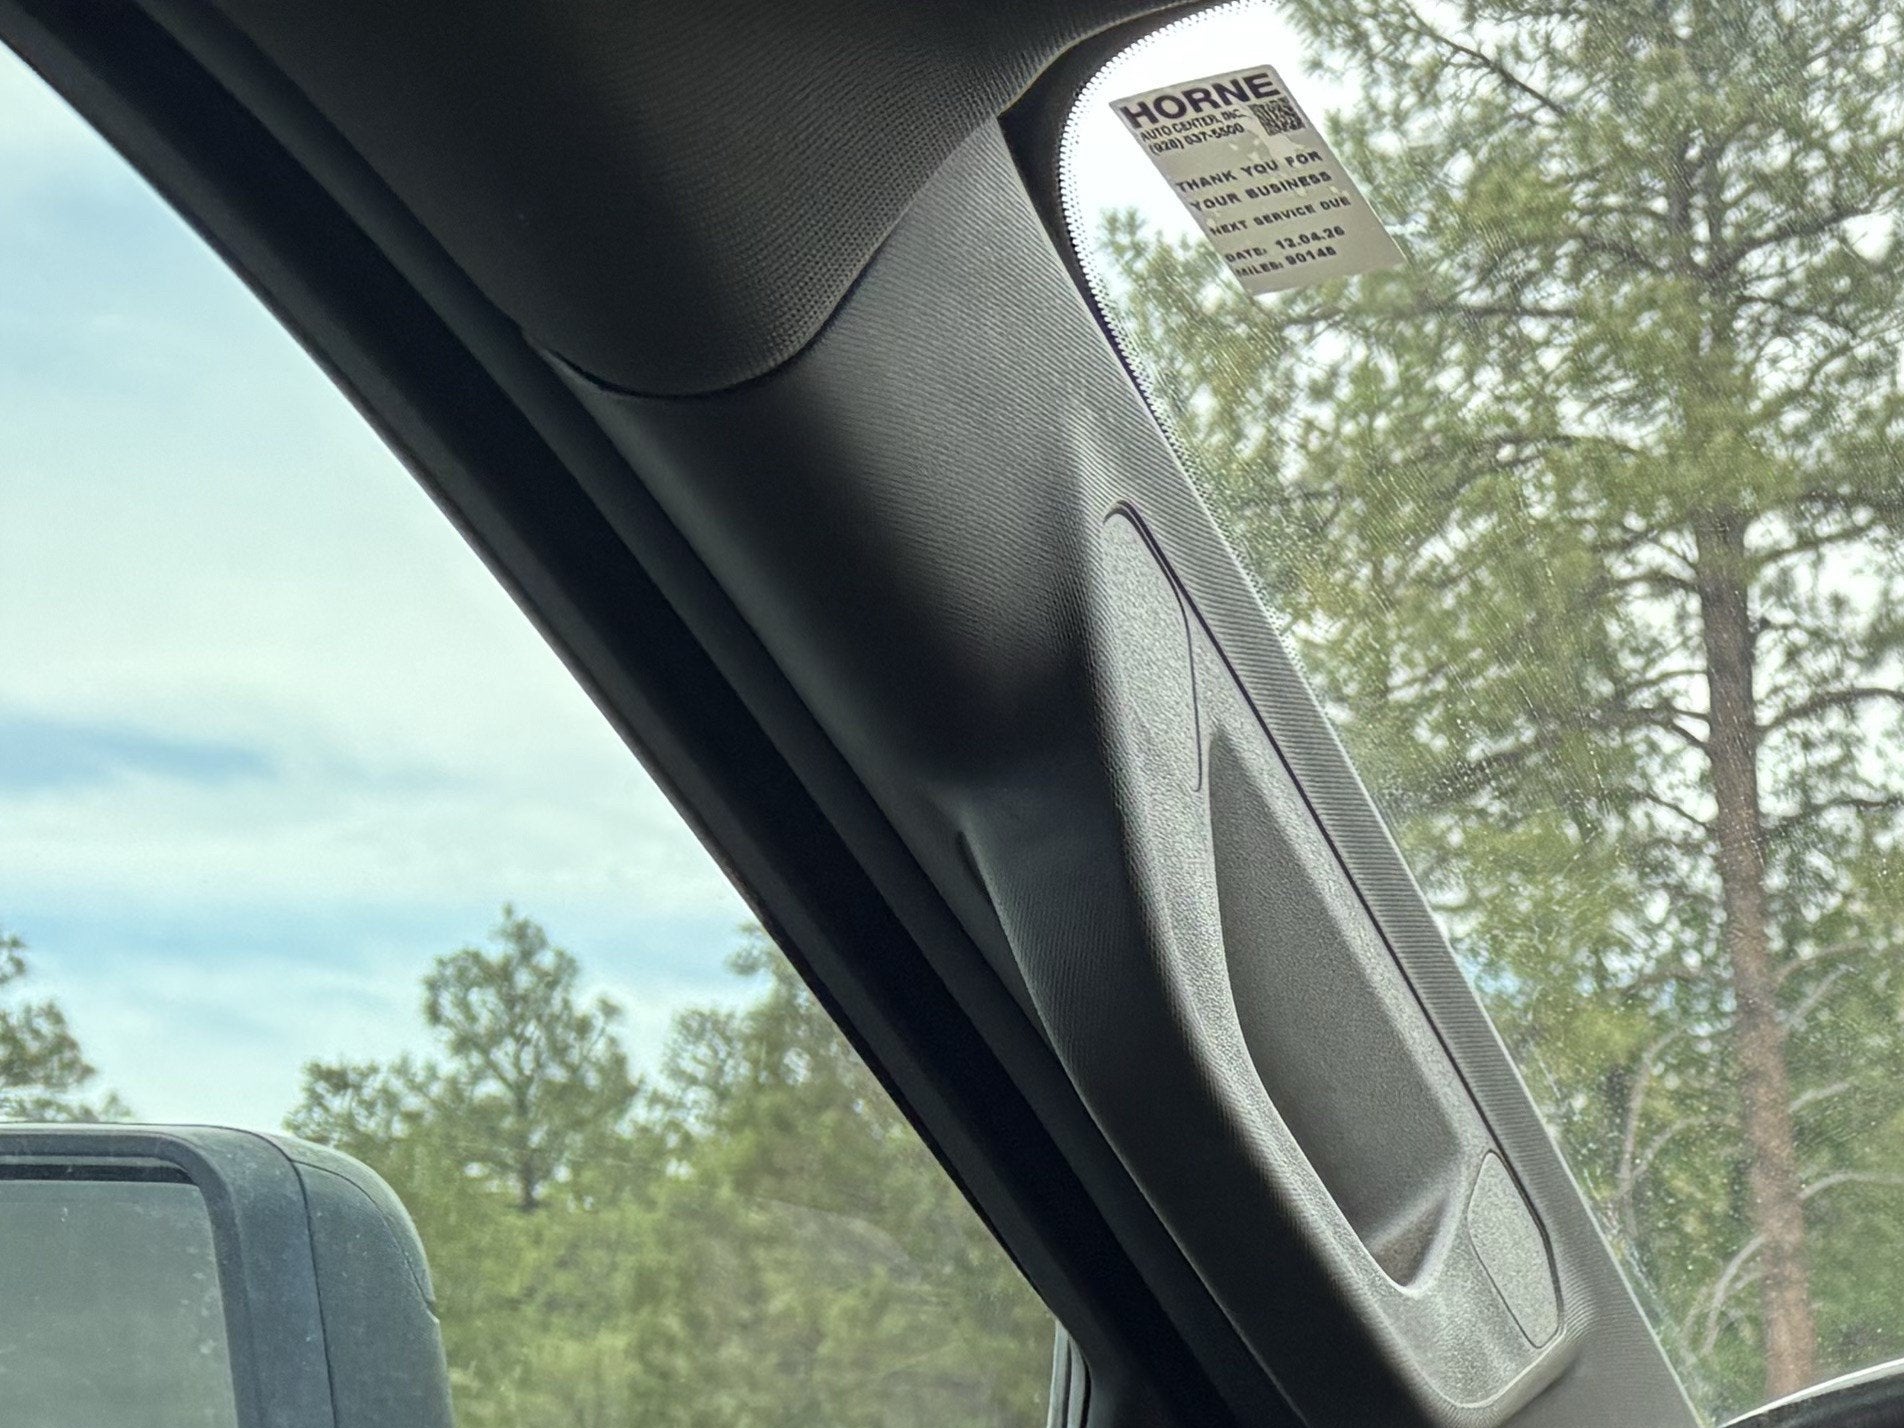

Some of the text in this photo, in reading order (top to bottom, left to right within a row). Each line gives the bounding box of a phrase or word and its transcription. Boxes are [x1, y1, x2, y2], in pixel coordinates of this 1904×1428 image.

[1123, 72, 1281, 128] HORNE
[1139, 125, 1173, 143] AUTO
[1175, 151, 1324, 193] THANK YOU FOR
[1190, 171, 1333, 213] YOUR BUSINESS
[1210, 196, 1352, 236] NEXT SERVICE DUE
